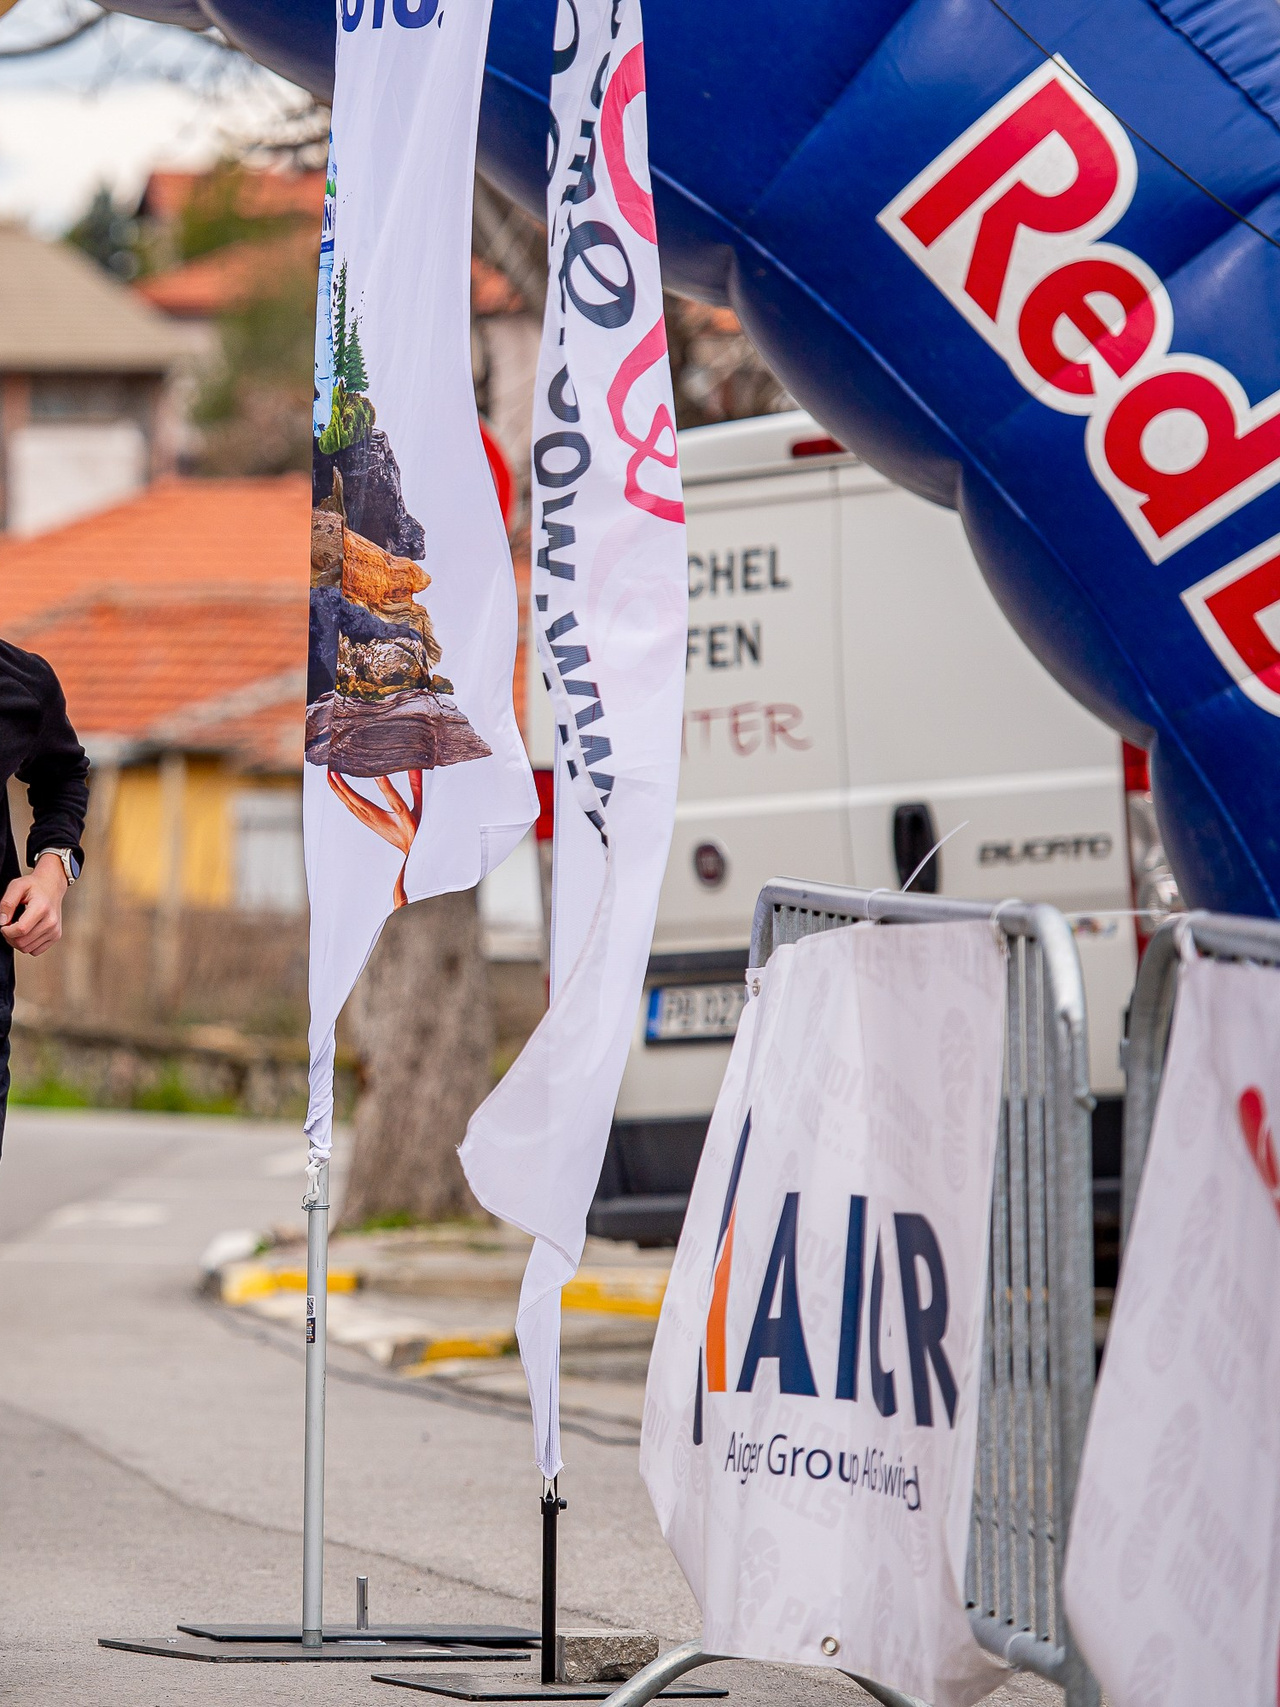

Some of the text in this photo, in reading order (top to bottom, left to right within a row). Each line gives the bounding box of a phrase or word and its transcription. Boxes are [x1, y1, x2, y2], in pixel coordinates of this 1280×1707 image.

[888, 66, 1280, 550] Red
[681, 702, 813, 757] TER
[978, 834, 1112, 866] DUCATO
[724, 1431, 764, 1485] Aiger
[767, 1433, 860, 1496] Group
